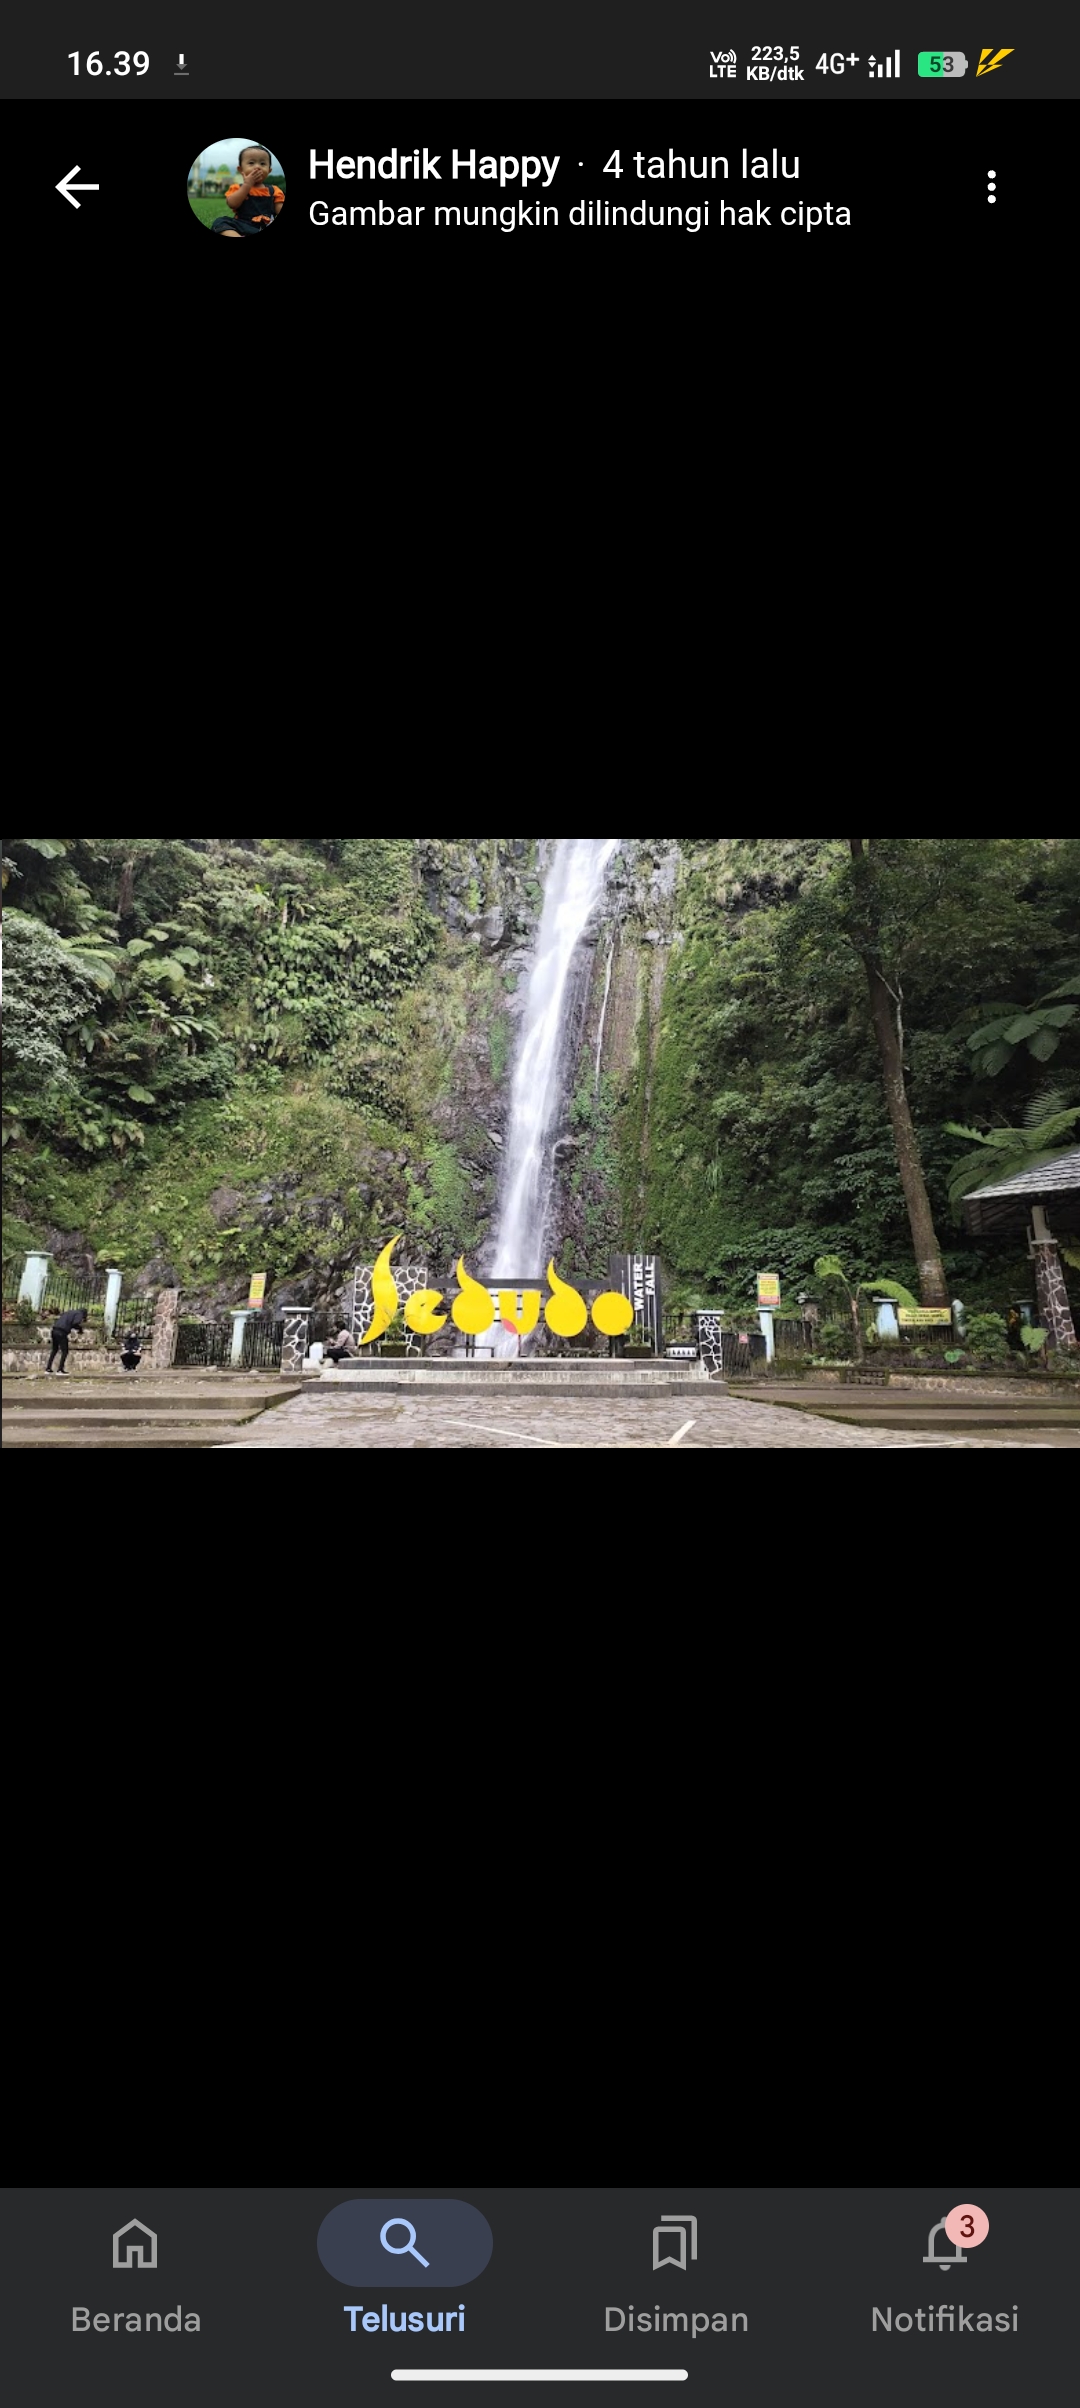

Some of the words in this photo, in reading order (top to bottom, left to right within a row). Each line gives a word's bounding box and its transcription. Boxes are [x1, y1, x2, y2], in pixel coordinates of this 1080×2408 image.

[67, 51, 150, 77] 16.39
[750, 46, 800, 62] 223,5
[815, 52, 860, 75] 4G+
[929, 56, 955, 73] 53
[709, 64, 737, 78] LTE
[746, 65, 805, 82] KB/dtk
[310, 147, 443, 180] Hendrik
[451, 148, 561, 188] Happy
[602, 149, 624, 179] 4
[632, 147, 729, 179] tahun
[742, 147, 800, 179] lalu
[309, 199, 426, 226] Gambar
[434, 199, 559, 233] mungkin
[568, 199, 710, 233] dilindungi
[720, 199, 772, 226] hak
[780, 200, 852, 233] cipta
[633, 1262, 644, 1311] WATER
[645, 1263, 656, 1296] FALL
[958, 2214, 976, 2239] 3
[72, 2304, 201, 2333] Beranda
[343, 2303, 466, 2333] Telusuri
[605, 2304, 748, 2339] Disimpan
[872, 2304, 1019, 2333] Notifikasi
